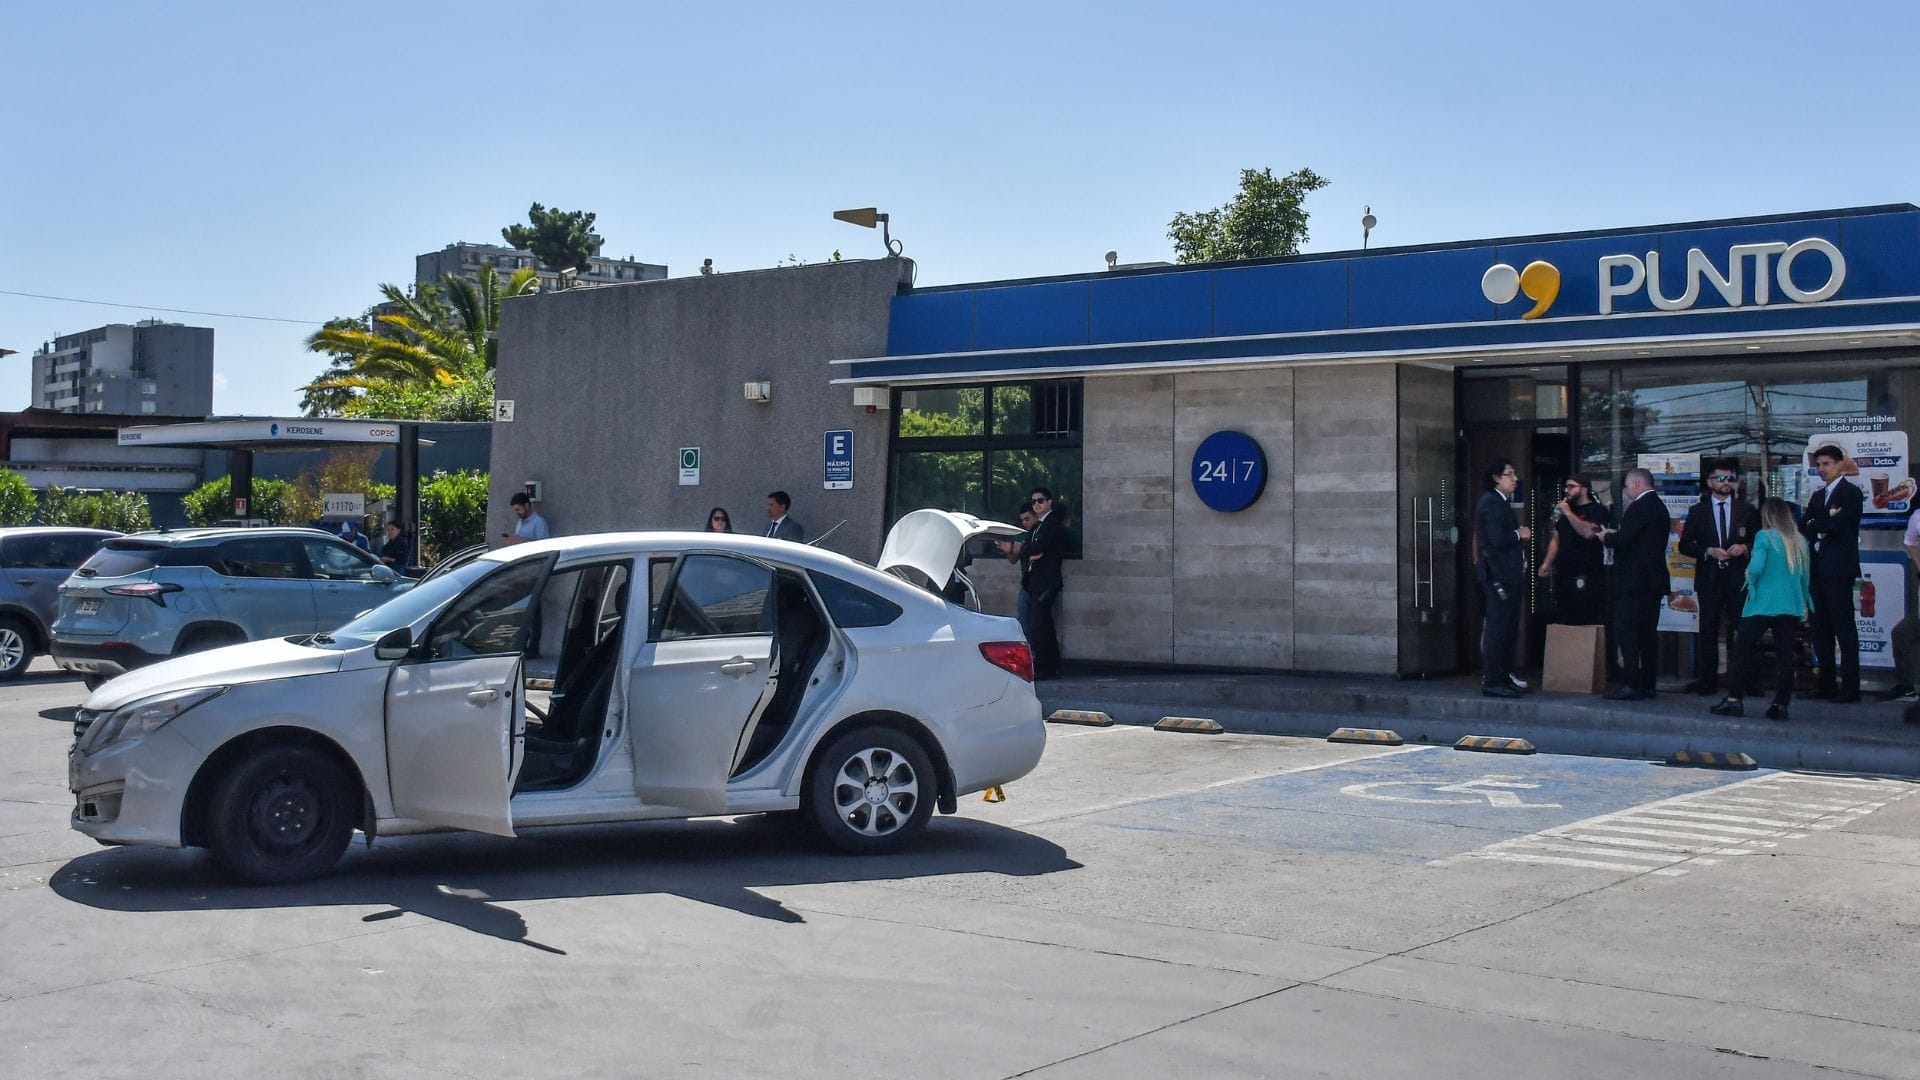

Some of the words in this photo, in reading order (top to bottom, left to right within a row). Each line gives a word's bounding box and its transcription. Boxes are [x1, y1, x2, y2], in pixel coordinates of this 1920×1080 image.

[1599, 237, 1846, 315] PUNTO
[1815, 416, 1847, 424] Promos
[286, 426, 324, 435] KEROSENE
[369, 429, 395, 437] COPEC
[833, 435, 845, 455] E
[324, 501, 330, 512] K
[1859, 641, 1880, 651] 290
